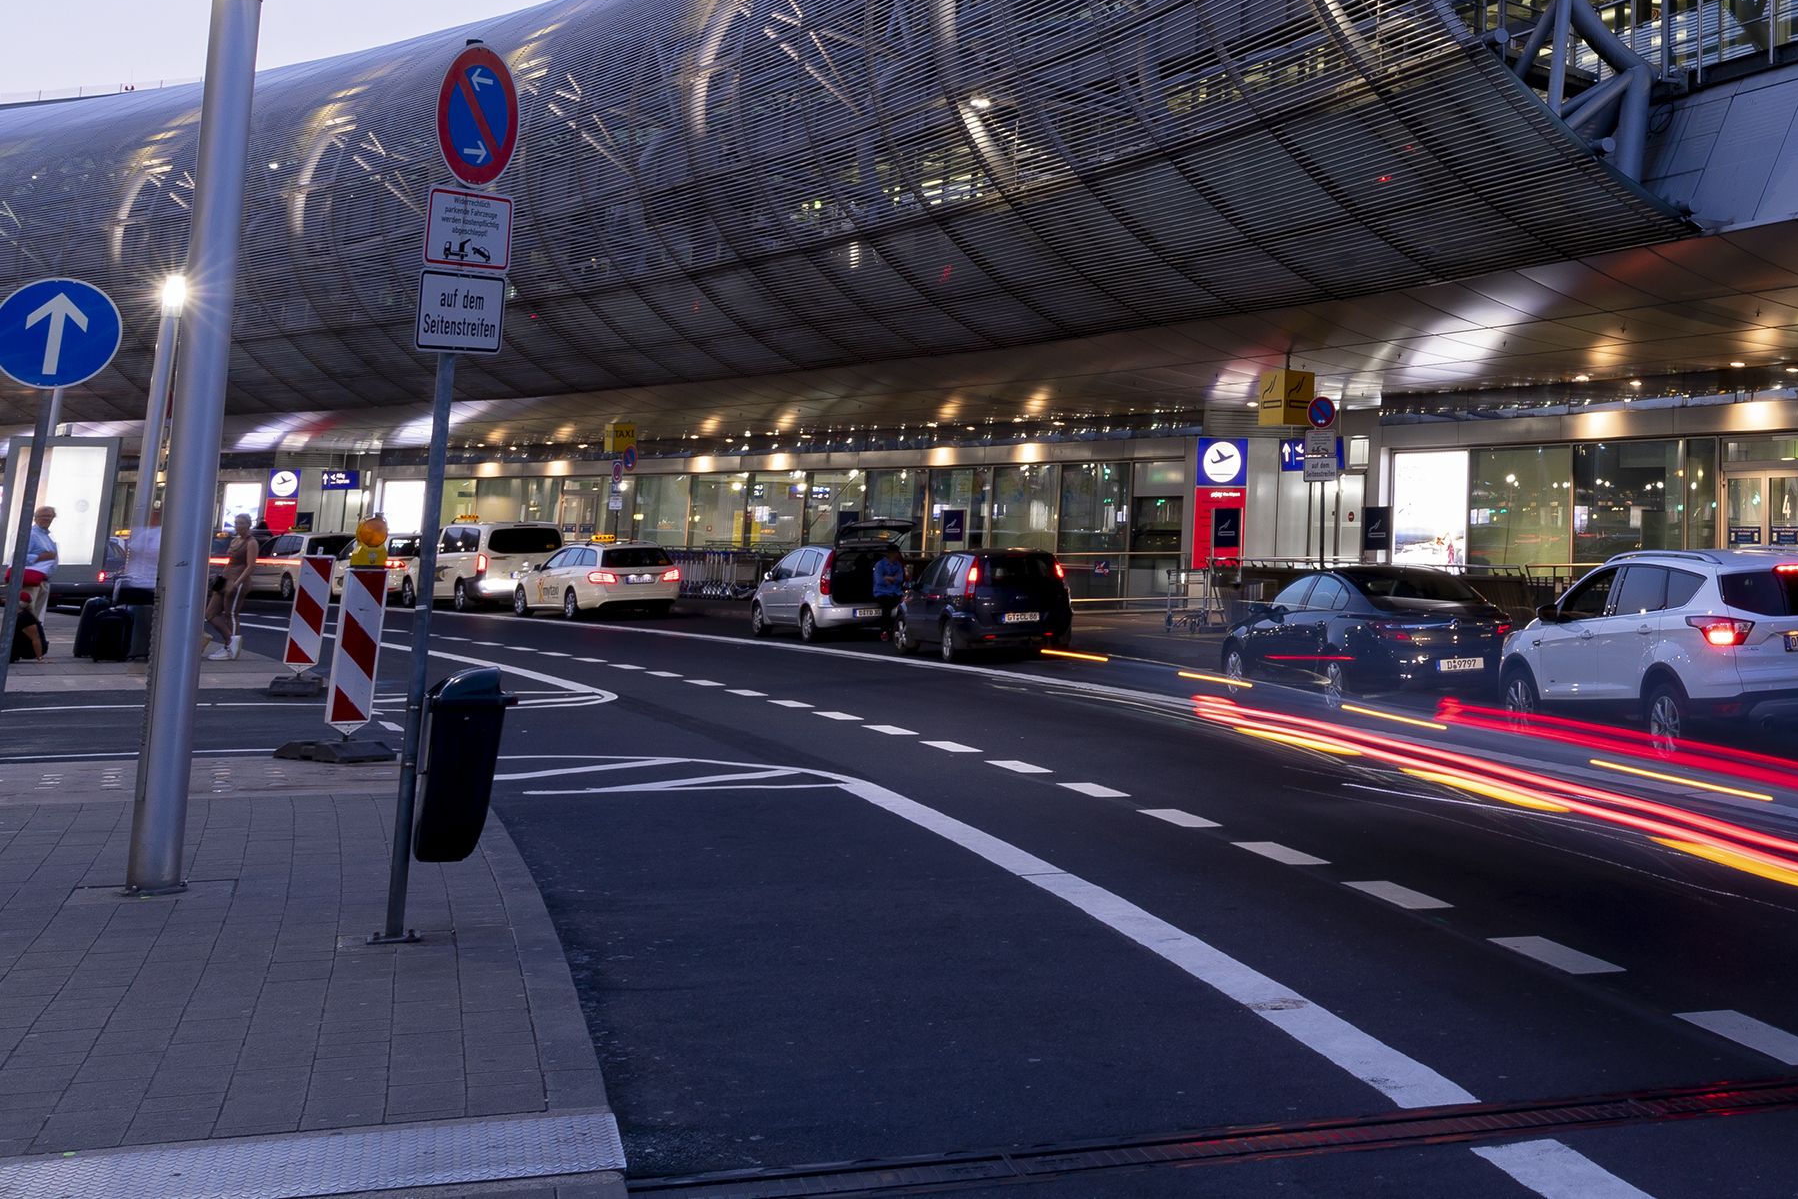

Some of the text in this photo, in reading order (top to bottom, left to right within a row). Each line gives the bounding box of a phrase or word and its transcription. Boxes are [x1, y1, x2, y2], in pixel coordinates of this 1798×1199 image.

[441, 215, 461, 224] werden
[445, 206, 498, 220] parkende Fahrzeuge
[440, 288, 485, 310] auf dem
[423, 313, 496, 338] Seitenstreifen
[615, 430, 635, 438] TAXI
[1782, 494, 1791, 519] 4
[543, 584, 559, 599] mytaxi
[1457, 659, 1477, 669] 9797
